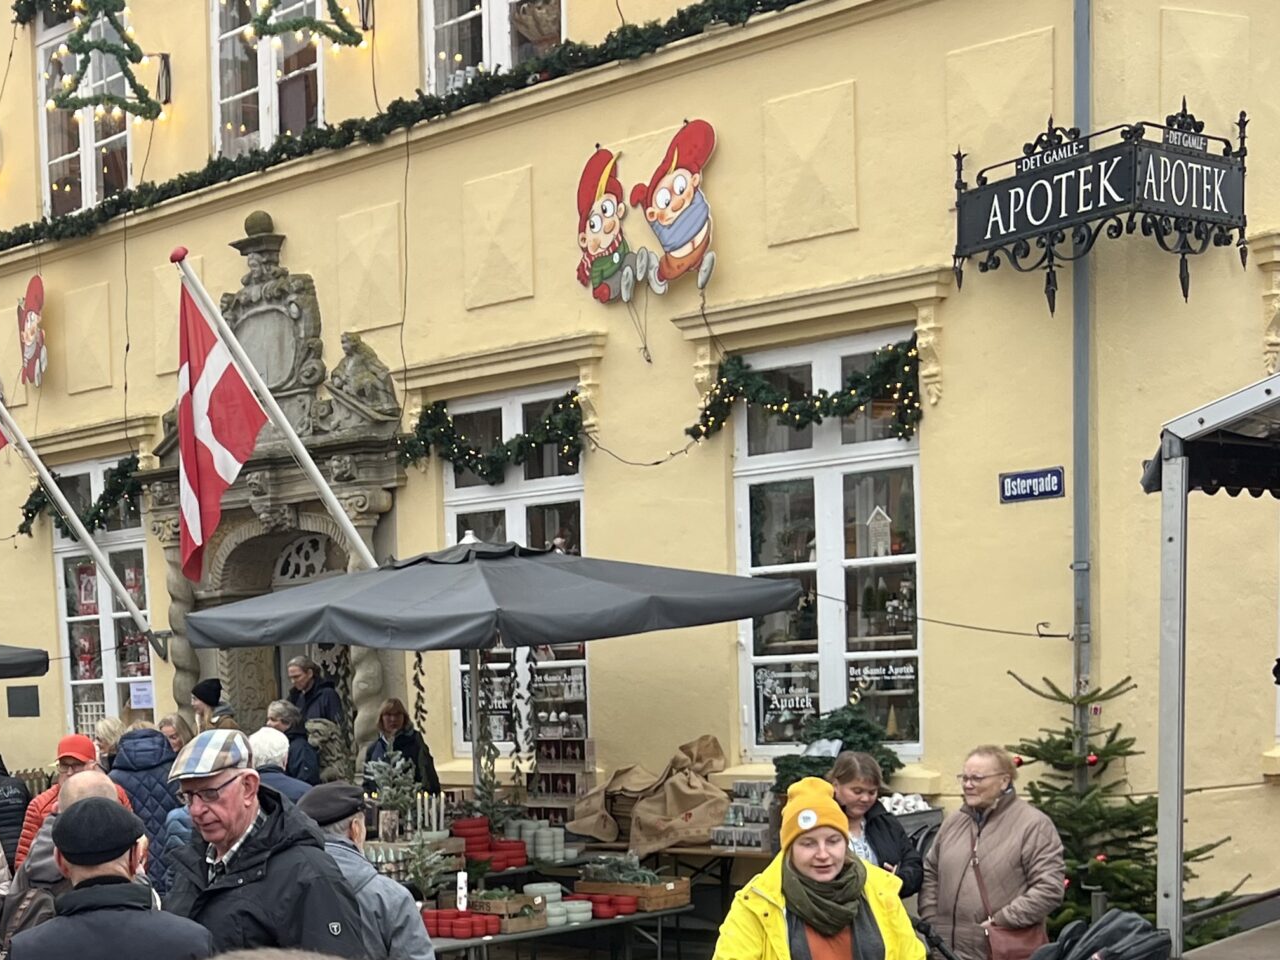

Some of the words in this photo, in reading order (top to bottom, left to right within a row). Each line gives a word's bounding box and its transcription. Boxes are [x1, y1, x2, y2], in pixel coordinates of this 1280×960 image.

[984, 155, 1124, 240] APOTEK
[1143, 153, 1229, 214] APOTEK
[769, 694, 812, 711] Apotek
